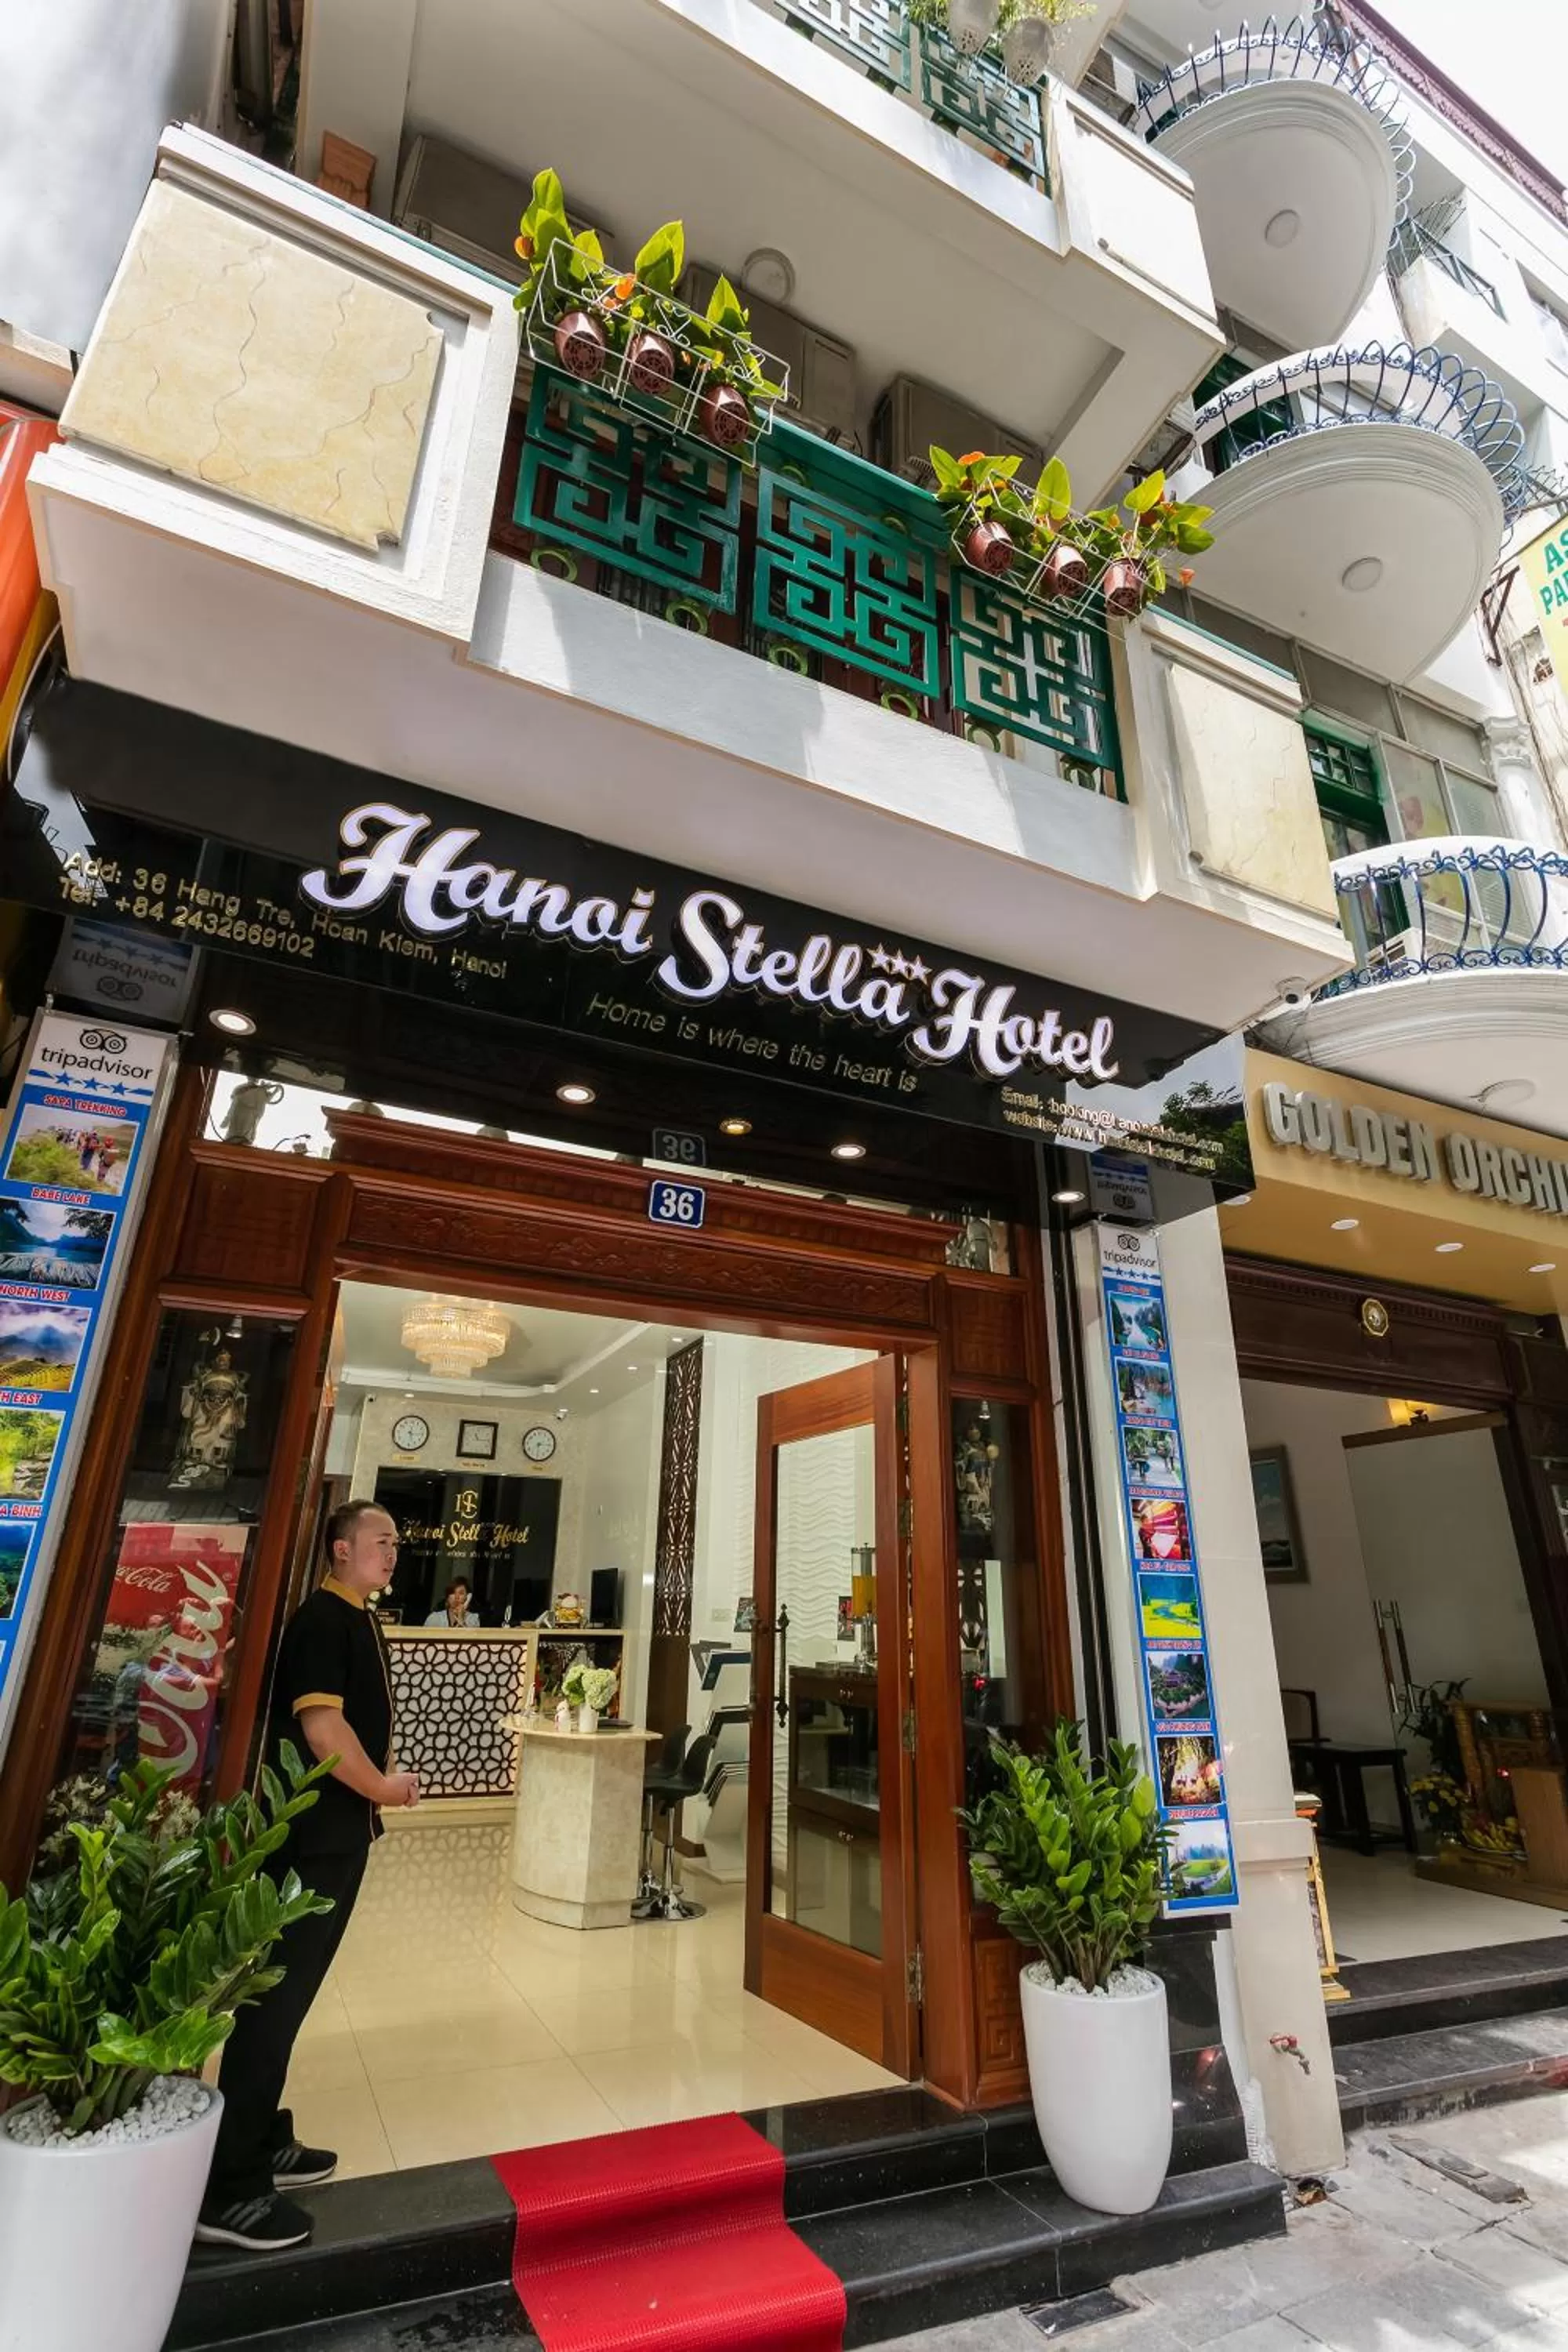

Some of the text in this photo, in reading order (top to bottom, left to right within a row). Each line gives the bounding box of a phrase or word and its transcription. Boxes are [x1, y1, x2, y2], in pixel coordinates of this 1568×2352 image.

[60, 876, 315, 959] Tel: +84 2432669102
[63, 852, 507, 979] Add: 36 Hang Tre, Hoan Kiem, Hanoi
[300, 803, 1120, 1080] Hanoi Stella Hotel
[41, 1045, 154, 1081] tripadvisor
[586, 992, 919, 1092] Home is where the heart is
[1263, 1081, 1568, 1216] GOLDEN ORCHI
[659, 1188, 695, 1221] 36
[40, 1288, 71, 1303] WEST
[13, 1390, 43, 1405] EAST
[10, 1504, 42, 1518] BINH
